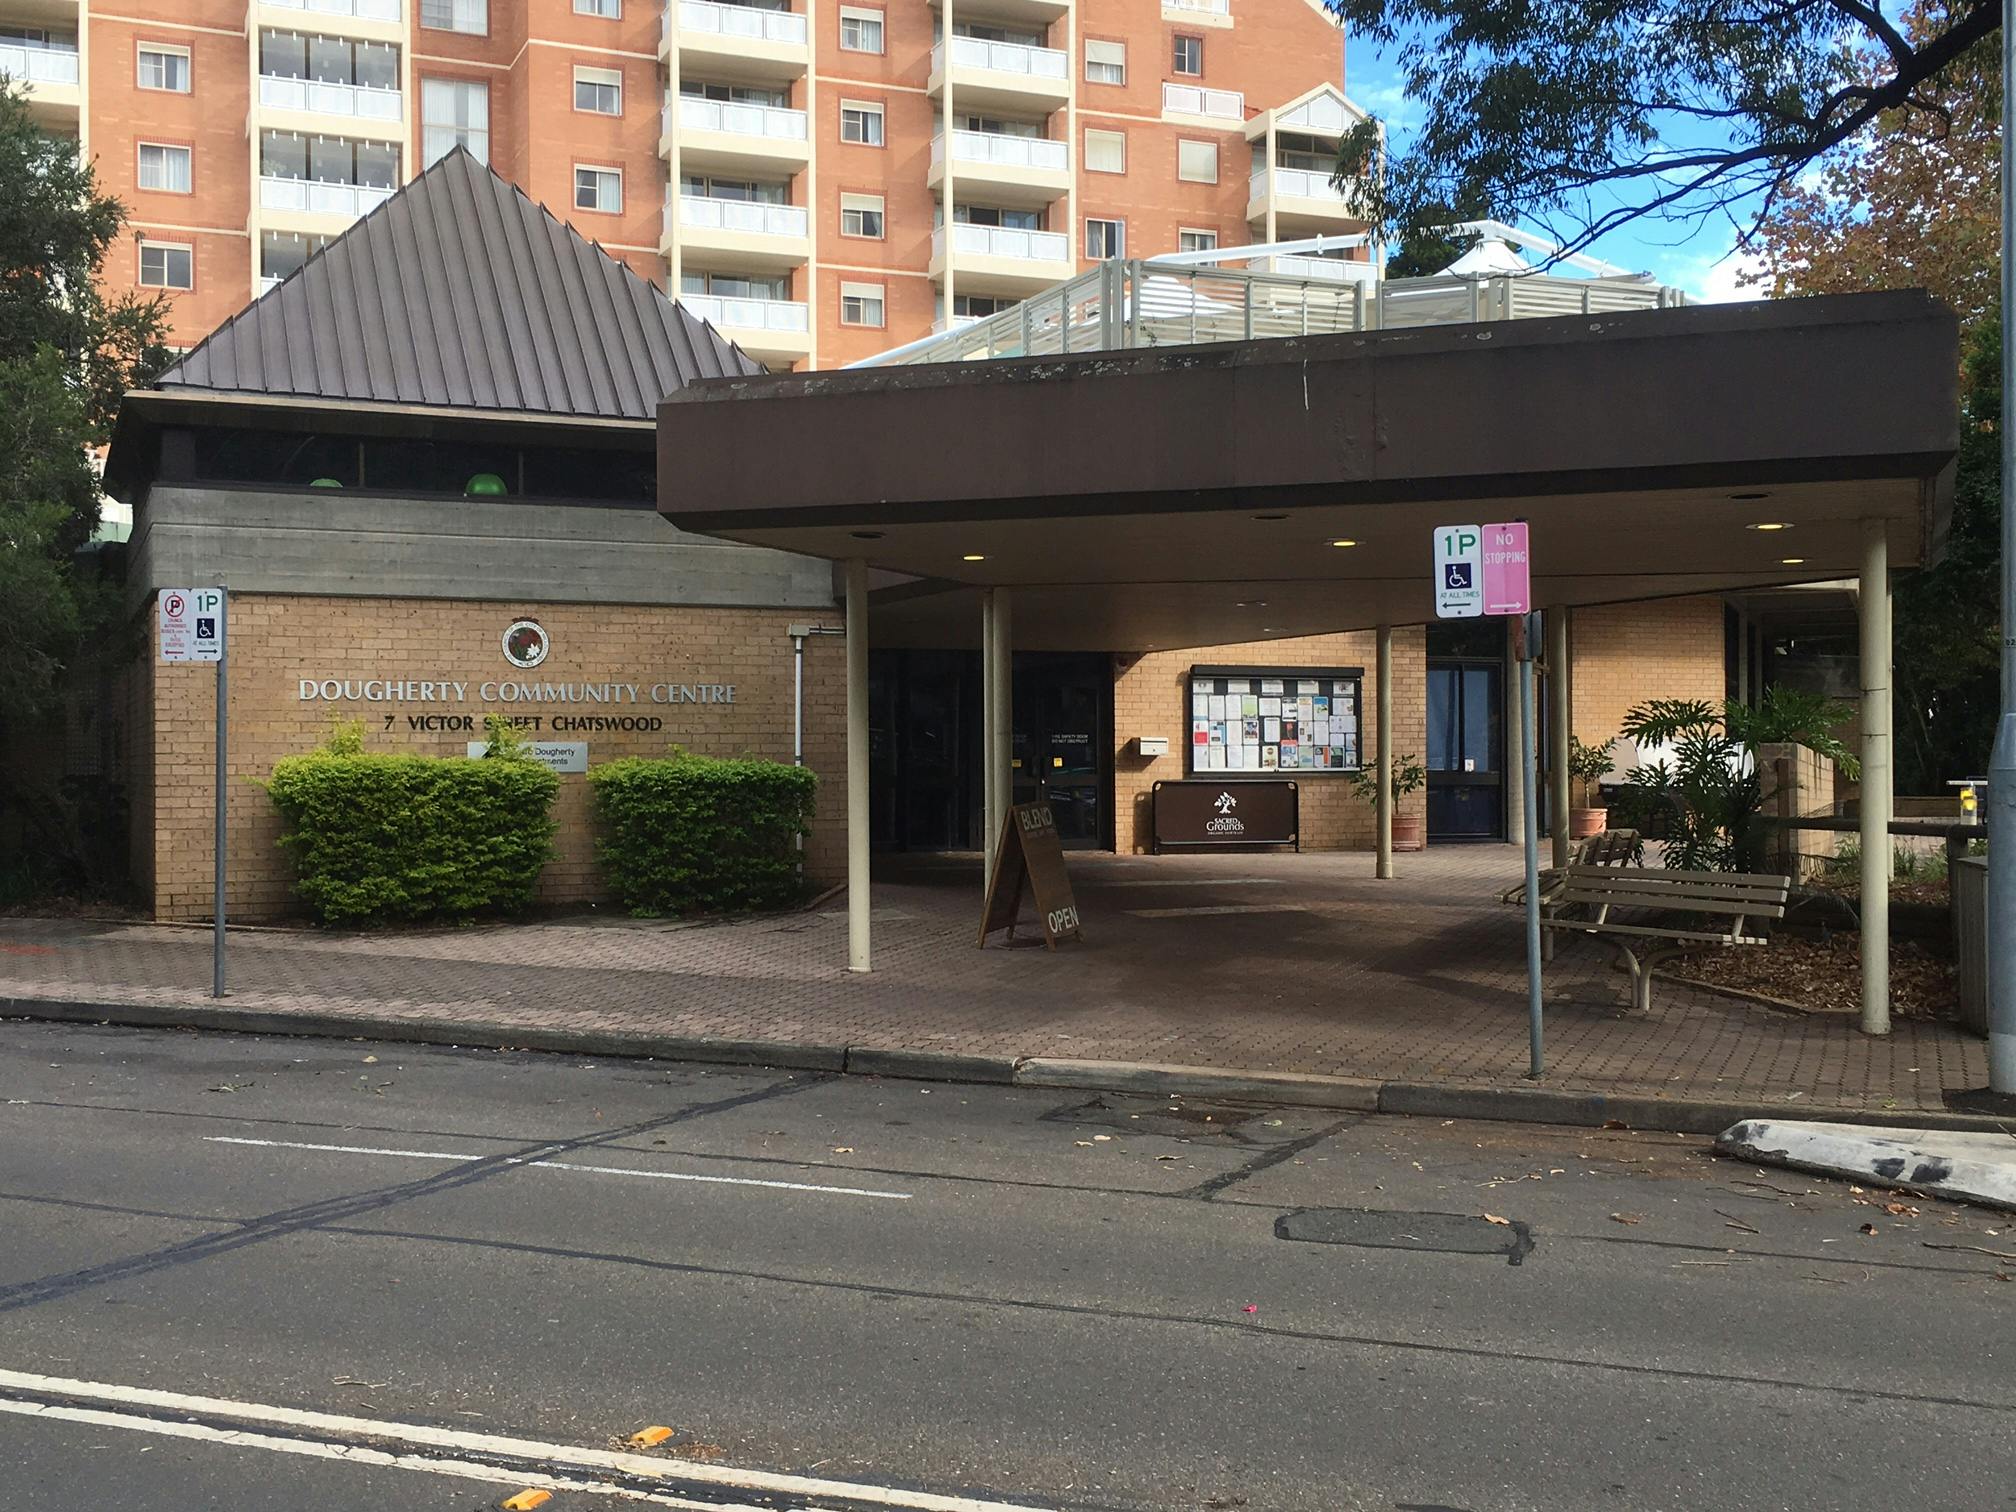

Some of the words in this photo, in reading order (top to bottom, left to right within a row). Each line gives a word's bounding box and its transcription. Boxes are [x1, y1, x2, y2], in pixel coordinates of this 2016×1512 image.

[1445, 534, 1476, 556] 1P
[1496, 534, 1514, 546] NO
[1485, 551, 1526, 564] STOPPING
[197, 595, 218, 612] 1P
[299, 679, 468, 702] DOUGHERTY
[480, 681, 640, 703] COMMUNITY
[651, 684, 737, 705] CENTRE
[384, 716, 395, 731] 7
[408, 716, 474, 731] VICTOR
[552, 716, 663, 732] CHATSWOOD
[535, 748, 575, 757] Dougherty
[1021, 806, 1053, 831] BLEND
[1206, 821, 1245, 831] Grounds
[1048, 906, 1079, 933] OPEN
